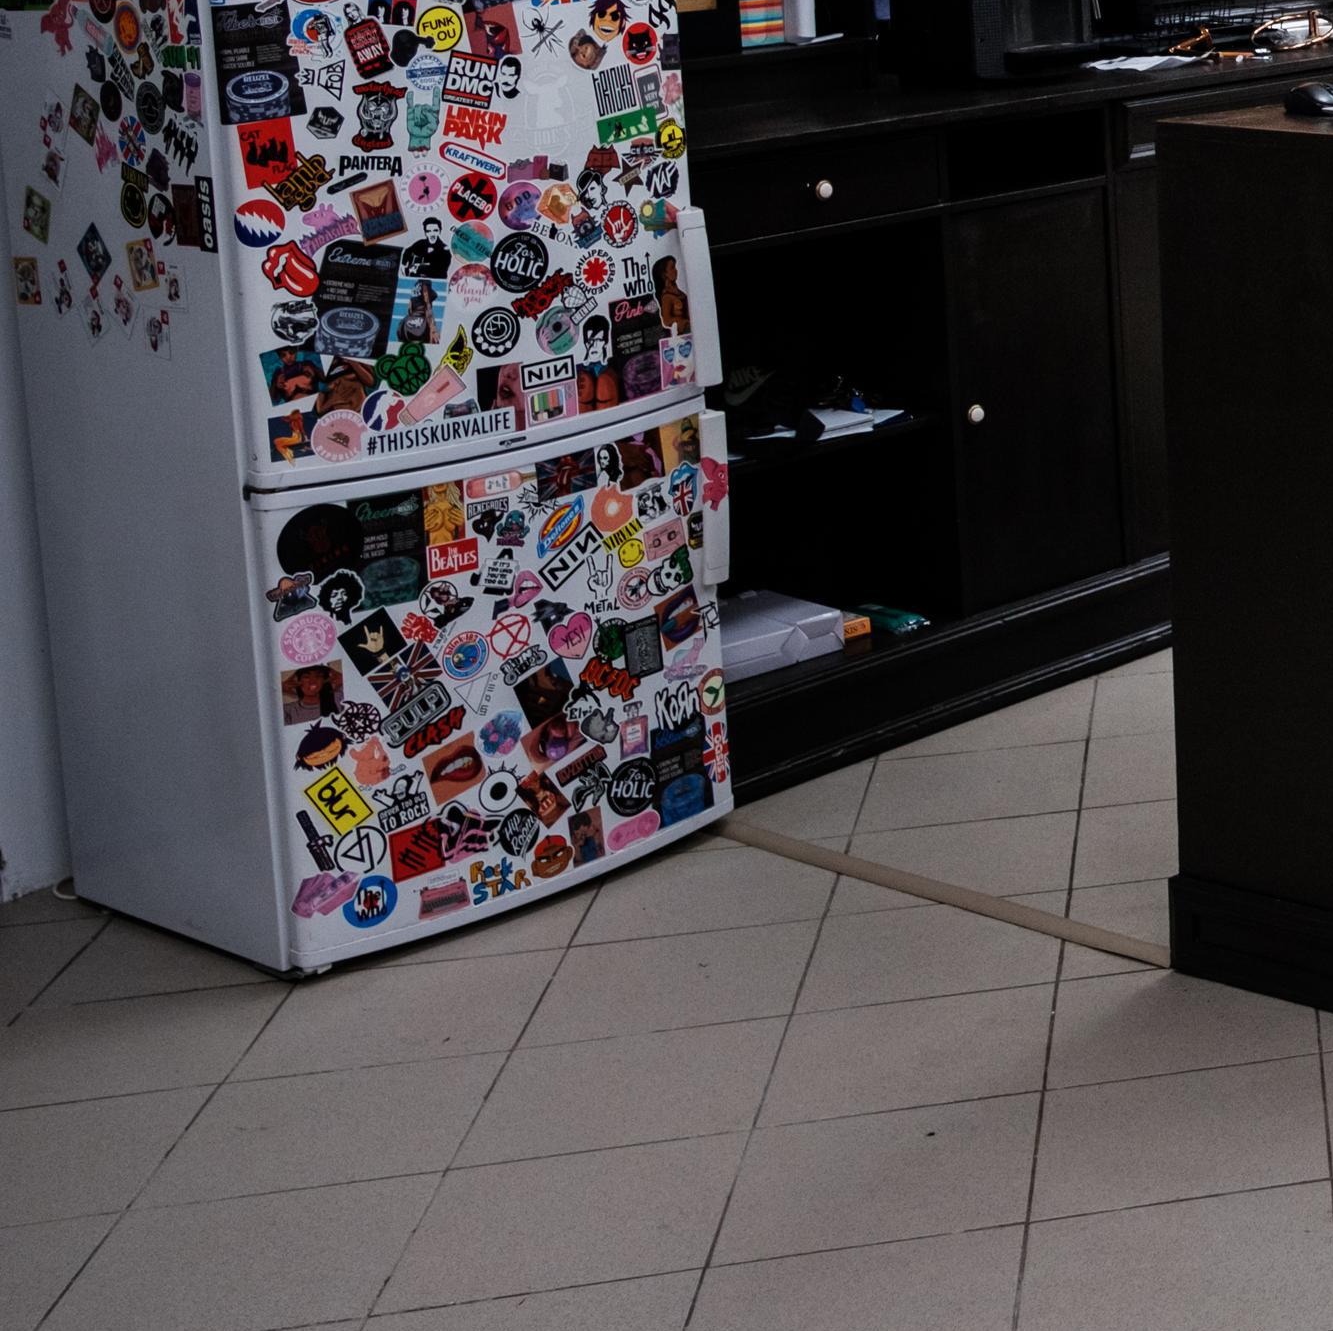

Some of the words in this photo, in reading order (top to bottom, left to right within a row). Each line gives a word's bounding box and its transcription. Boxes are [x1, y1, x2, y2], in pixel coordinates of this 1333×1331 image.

[421, 16, 455, 34] FUNK
[356, 43, 385, 63] AWAY
[328, 64, 343, 91] FOB
[450, 56, 496, 79] RUN
[446, 76, 494, 97] DMC
[447, 104, 507, 129] LINKIN
[240, 130, 261, 141] CAT
[443, 121, 506, 150] PARK
[339, 155, 402, 177] PANTERA
[445, 147, 502, 174] KRAFTWERK
[452, 181, 492, 214] PLACEBO
[201, 178, 215, 249] oasis
[493, 251, 543, 280] HOLIC
[614, 300, 644, 323] Pink
[527, 363, 570, 383] NIN
[367, 411, 511, 456] #THISISKURVALIFE
[467, 497, 509, 520] RENEGADES
[431, 547, 477, 572] BEATLES
[547, 530, 598, 582] NIN
[584, 597, 620, 615] METAL
[561, 626, 586, 650] YES!
[387, 690, 442, 740] PULP
[404, 706, 466, 758] CLASH
[317, 776, 357, 821] blur
[611, 780, 656, 800] HOLIC
[381, 818, 398, 833] TO
[399, 804, 429, 826] ROCK
